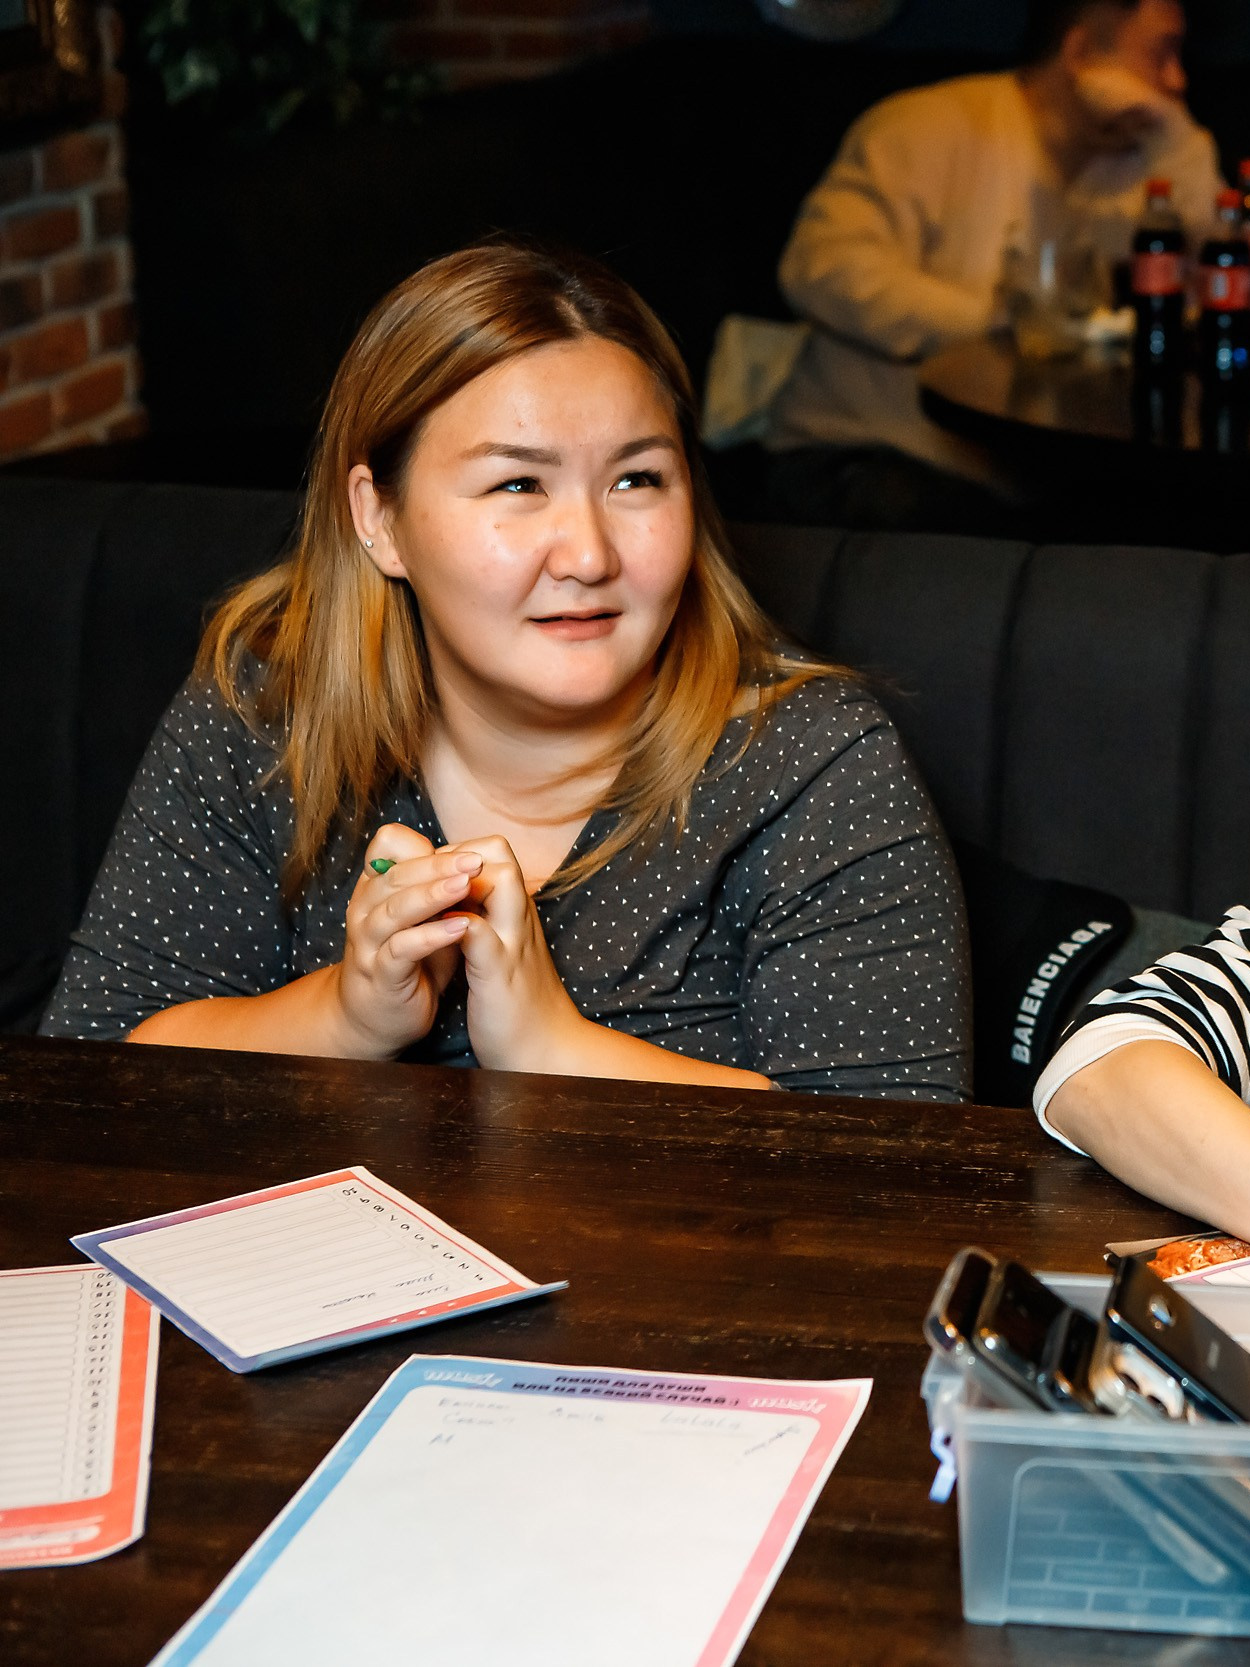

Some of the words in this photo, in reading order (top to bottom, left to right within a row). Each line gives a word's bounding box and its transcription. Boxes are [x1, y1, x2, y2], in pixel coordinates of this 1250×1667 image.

[512, 1382, 550, 1391] ИЛИ
[553, 1386, 576, 1394] НА
[655, 1393, 726, 1405] СЛУЧАЙ
[555, 1376, 610, 1385] ПИШИ
[612, 1380, 649, 1389] ДЛЯ
[652, 1383, 707, 1393] ДУШИ
